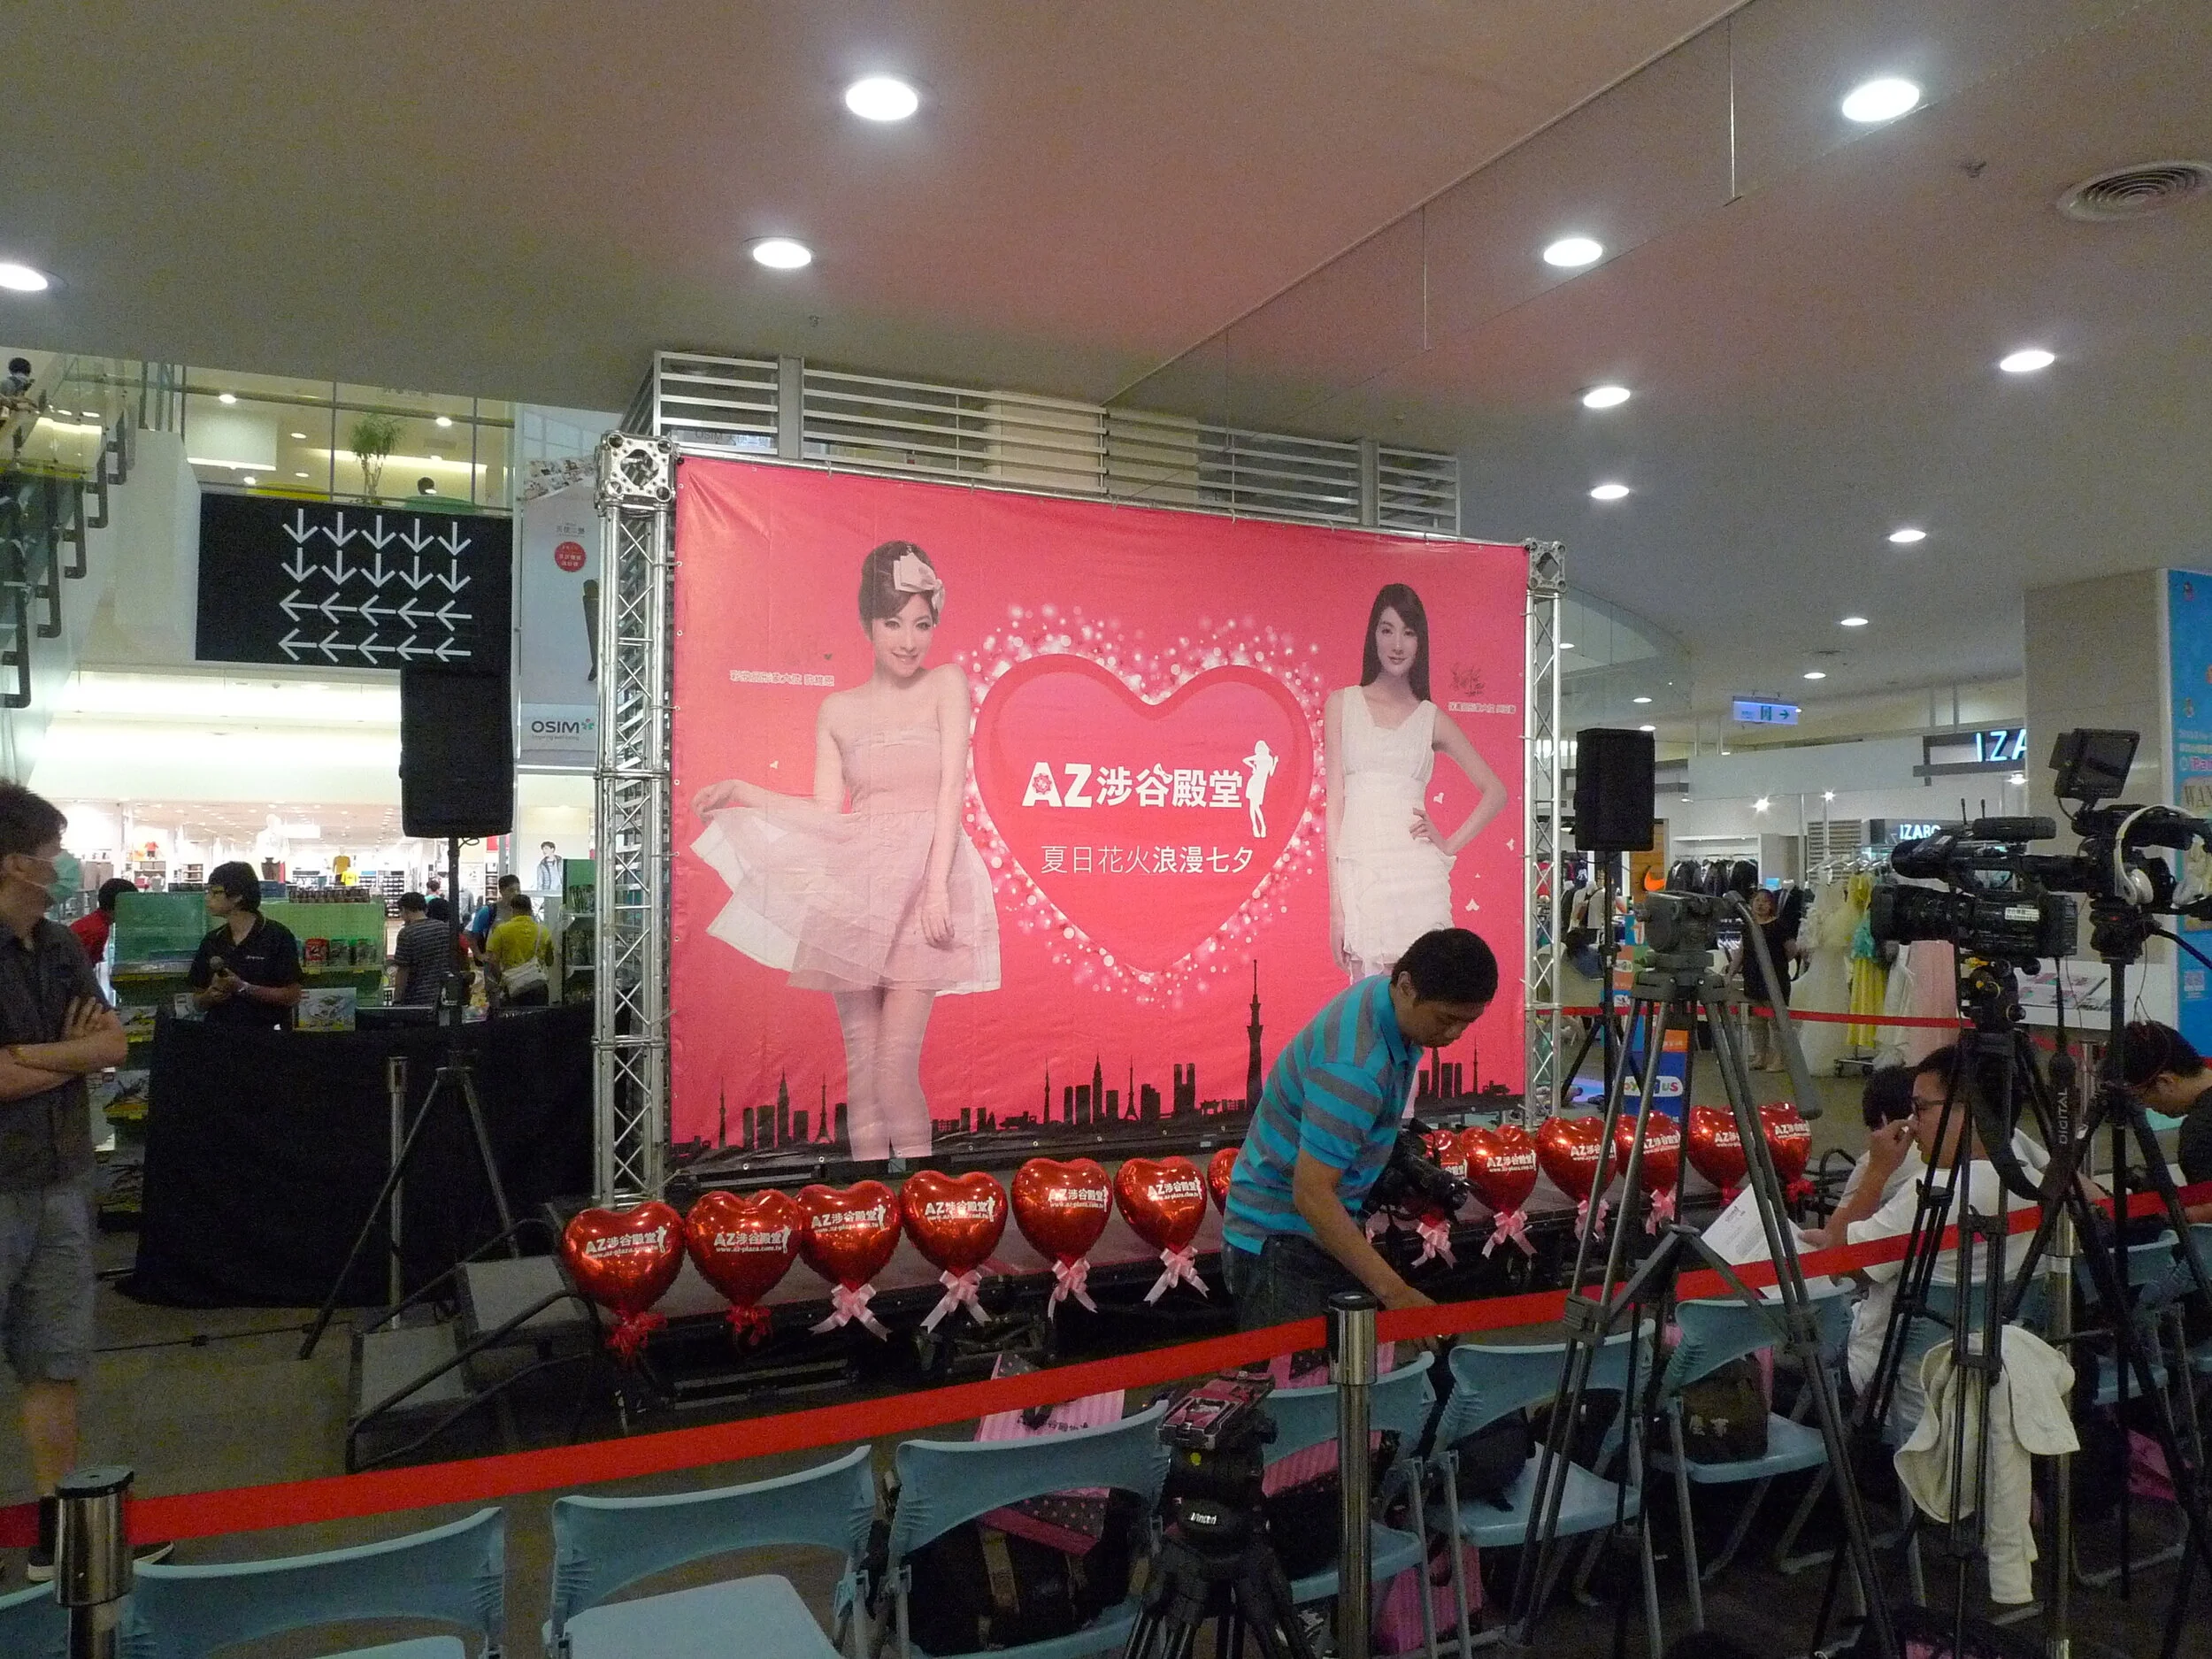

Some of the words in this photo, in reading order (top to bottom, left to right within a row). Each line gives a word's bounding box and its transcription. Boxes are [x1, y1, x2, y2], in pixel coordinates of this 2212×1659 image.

[531, 720, 580, 733] OSIM
[1021, 761, 1243, 809] AZ涉谷殿堂
[1041, 844, 1254, 874] 夏日花火浪漫七夕
